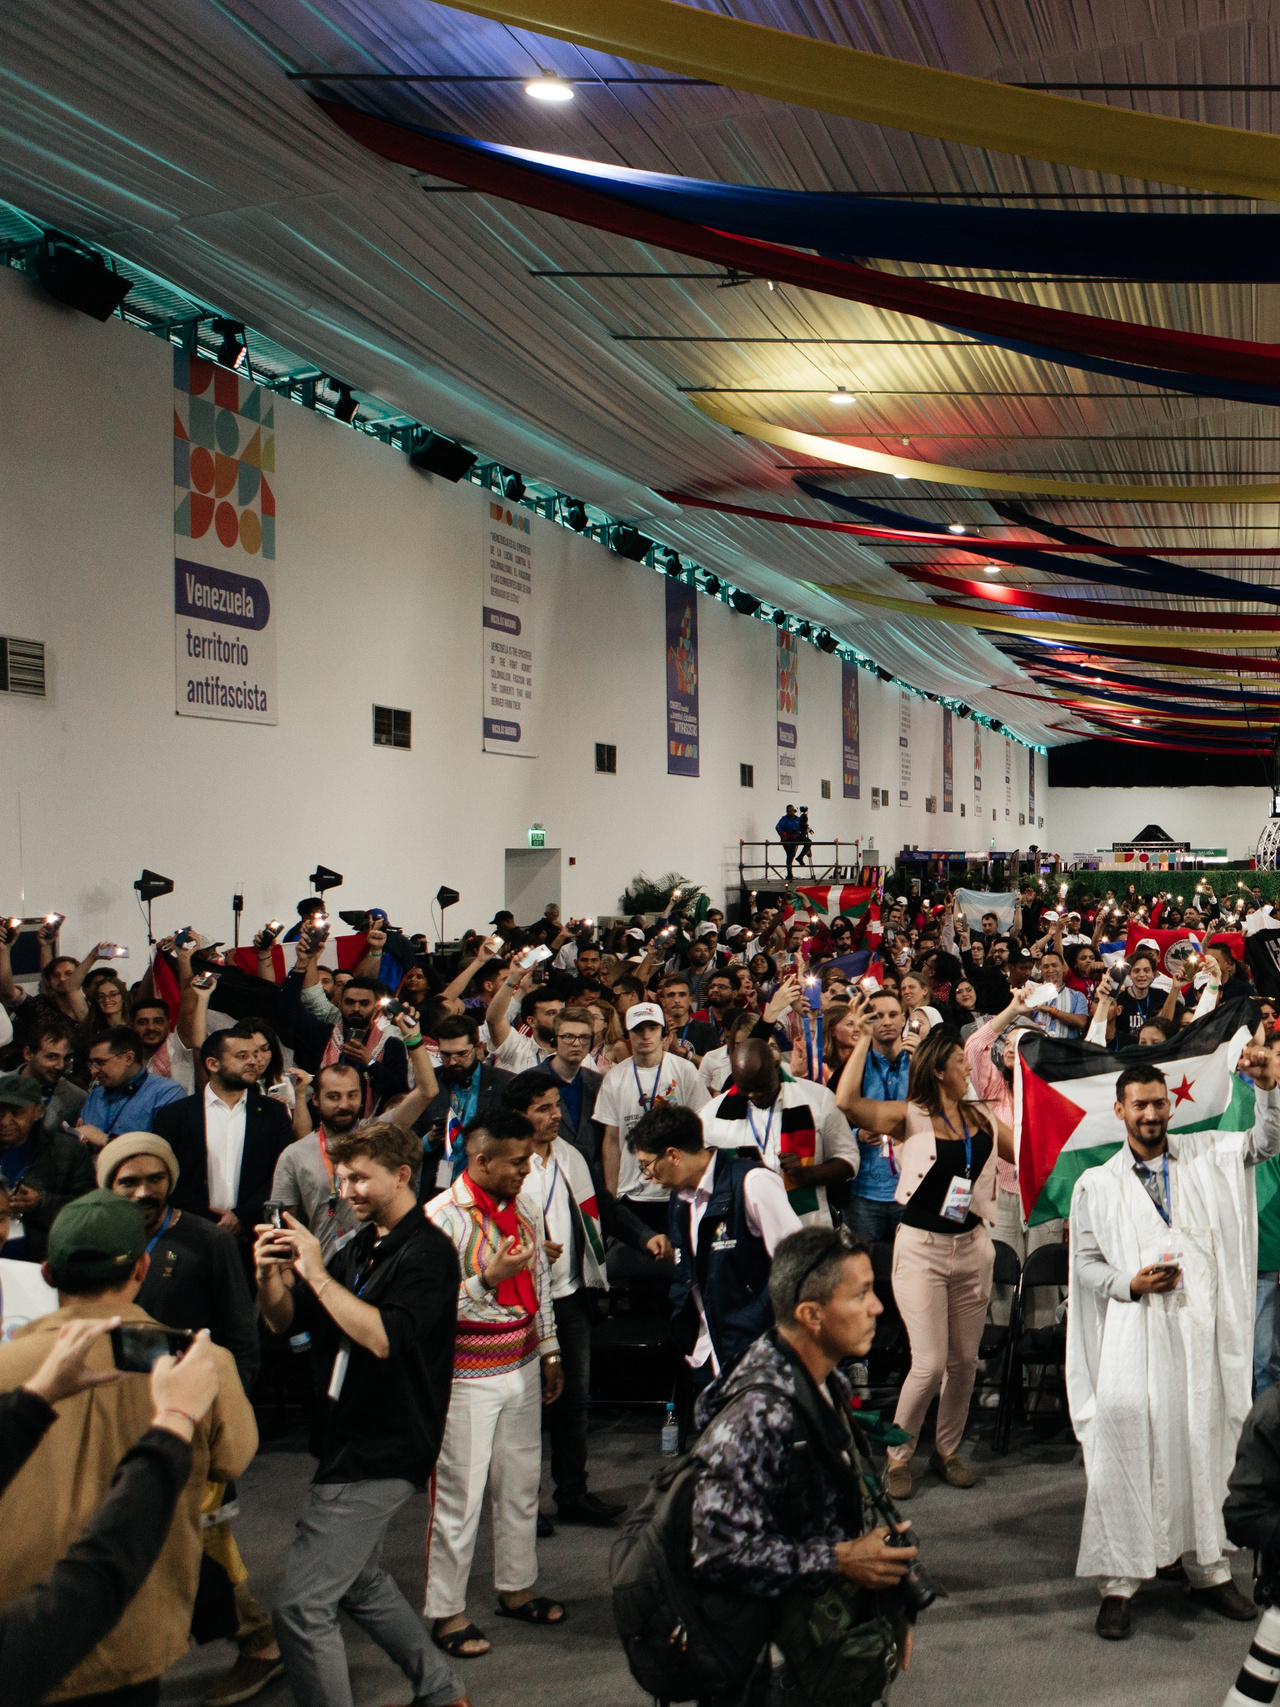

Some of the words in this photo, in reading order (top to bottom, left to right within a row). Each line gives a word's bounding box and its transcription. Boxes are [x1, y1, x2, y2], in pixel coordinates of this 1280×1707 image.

[186, 573, 254, 618] Venezuela
[186, 628, 248, 666] territorio
[187, 676, 267, 712] antifascista
